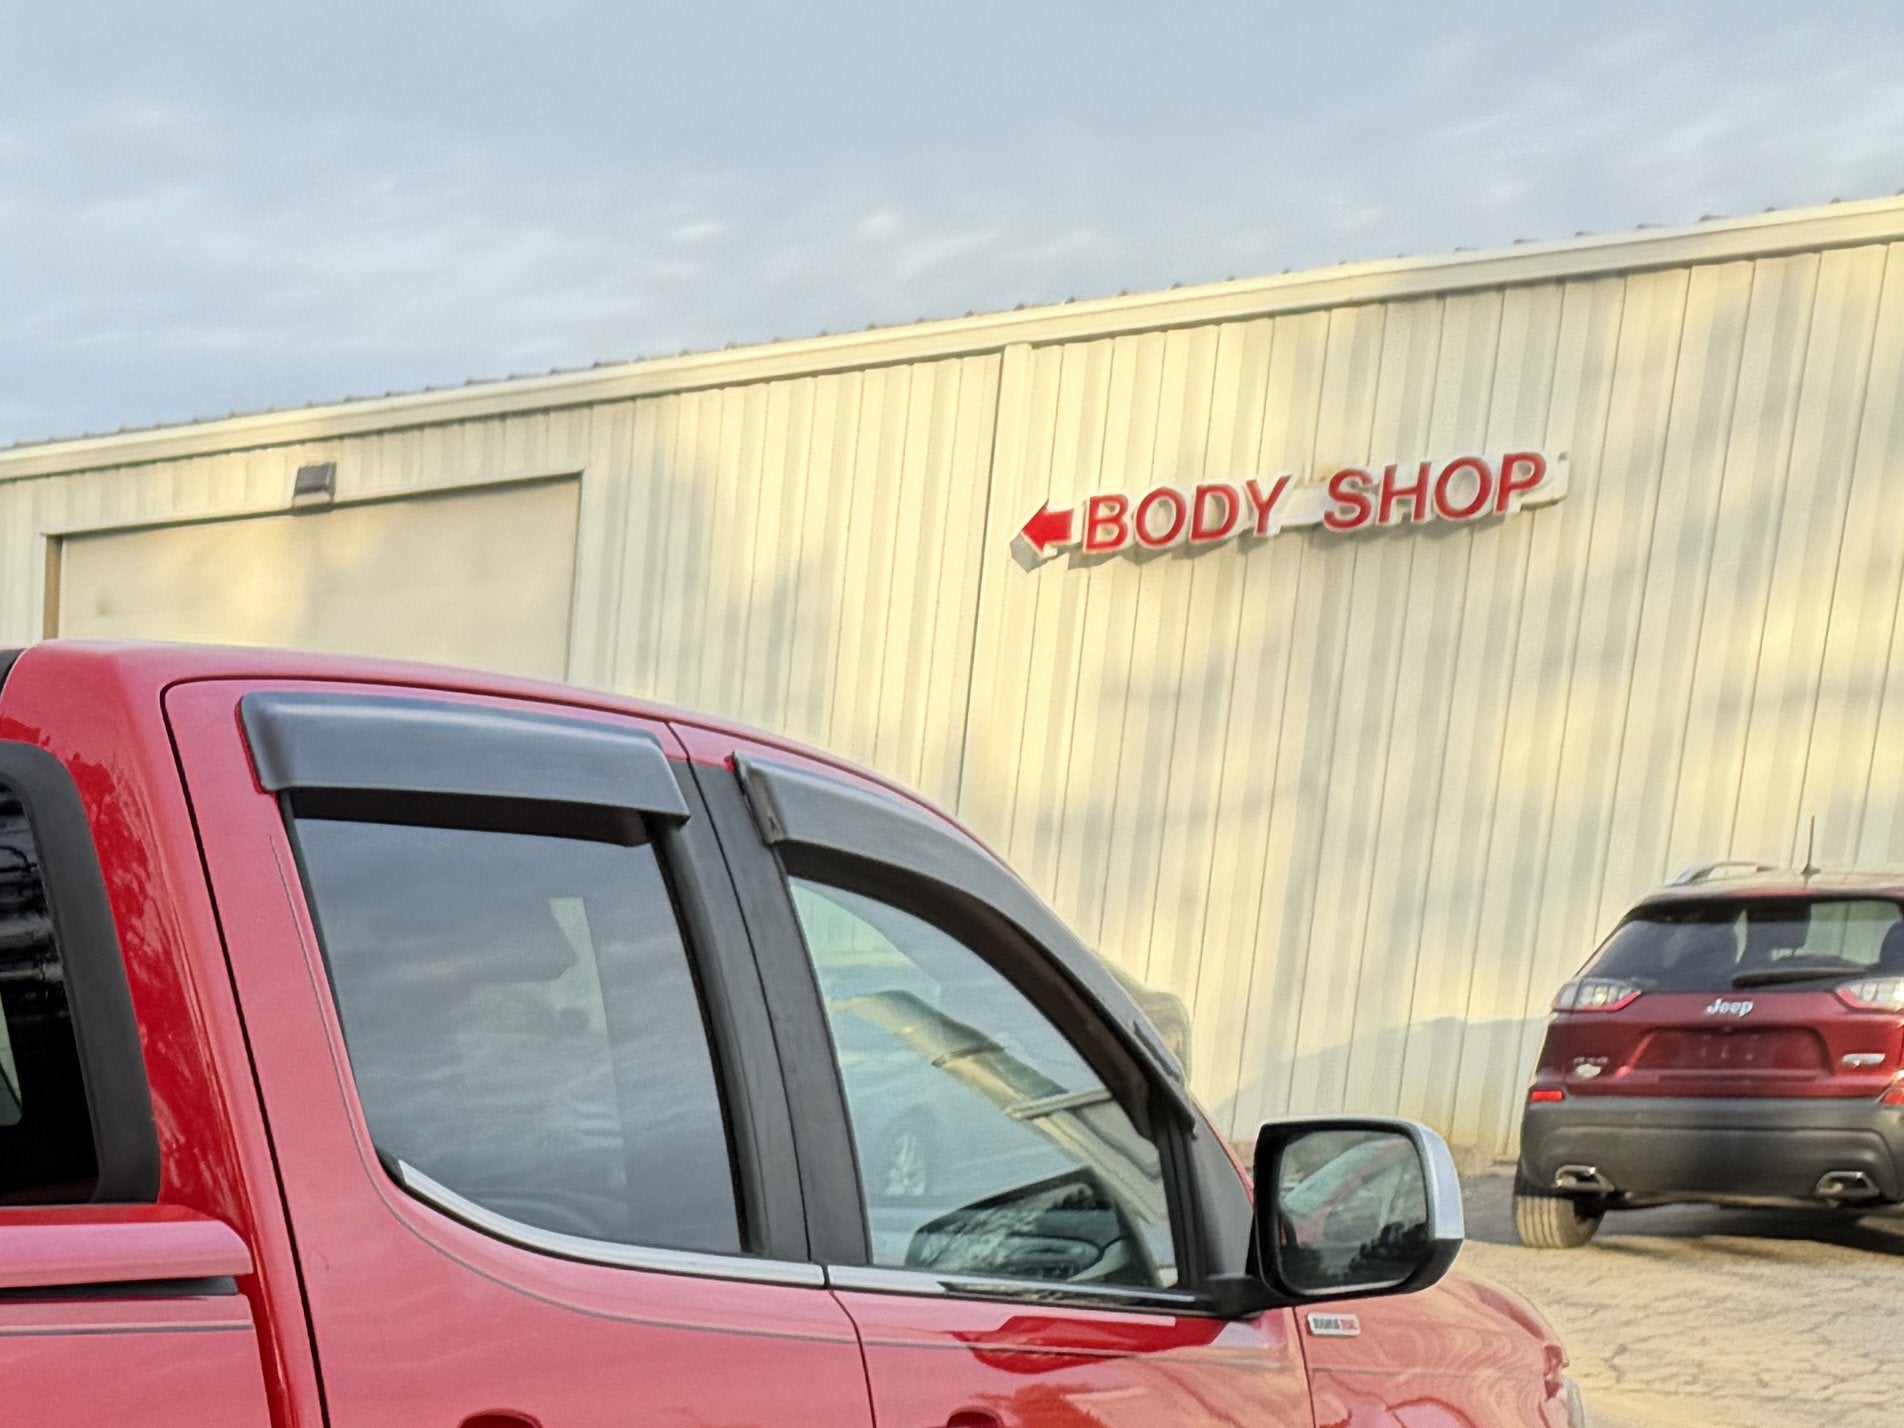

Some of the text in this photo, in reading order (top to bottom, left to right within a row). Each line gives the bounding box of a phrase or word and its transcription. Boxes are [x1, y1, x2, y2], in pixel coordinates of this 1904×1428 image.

[1083, 452, 1547, 555] BODY SHOP
[1707, 998, 1754, 1017] Jeep
